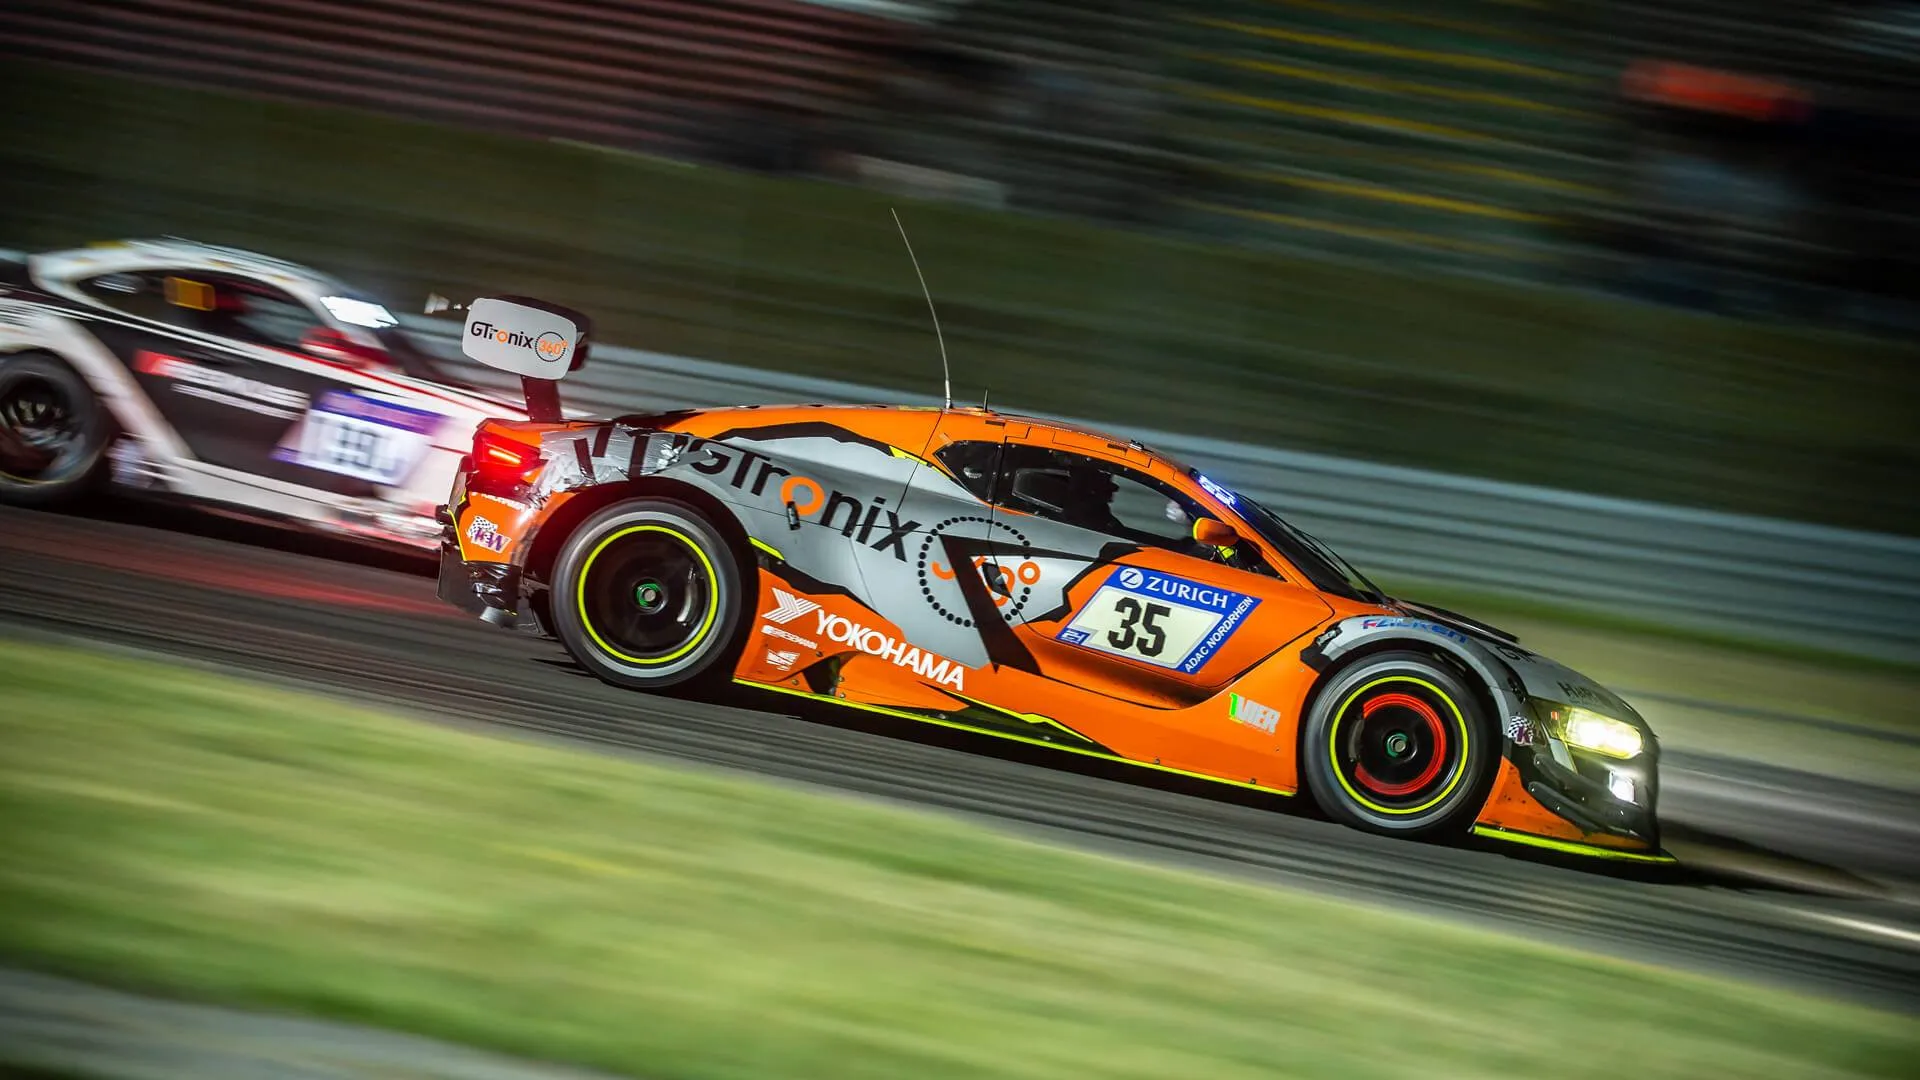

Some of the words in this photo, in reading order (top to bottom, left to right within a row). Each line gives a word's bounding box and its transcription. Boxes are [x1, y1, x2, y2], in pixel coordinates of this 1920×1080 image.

[471, 321, 534, 349] GTronix
[1146, 576, 1228, 609] ZURICH
[816, 609, 964, 691] YOKOHAMA
[1107, 597, 1171, 657] 35
[1184, 646, 1210, 673] ADAC
[1208, 597, 1254, 647] NORDRHEIN
